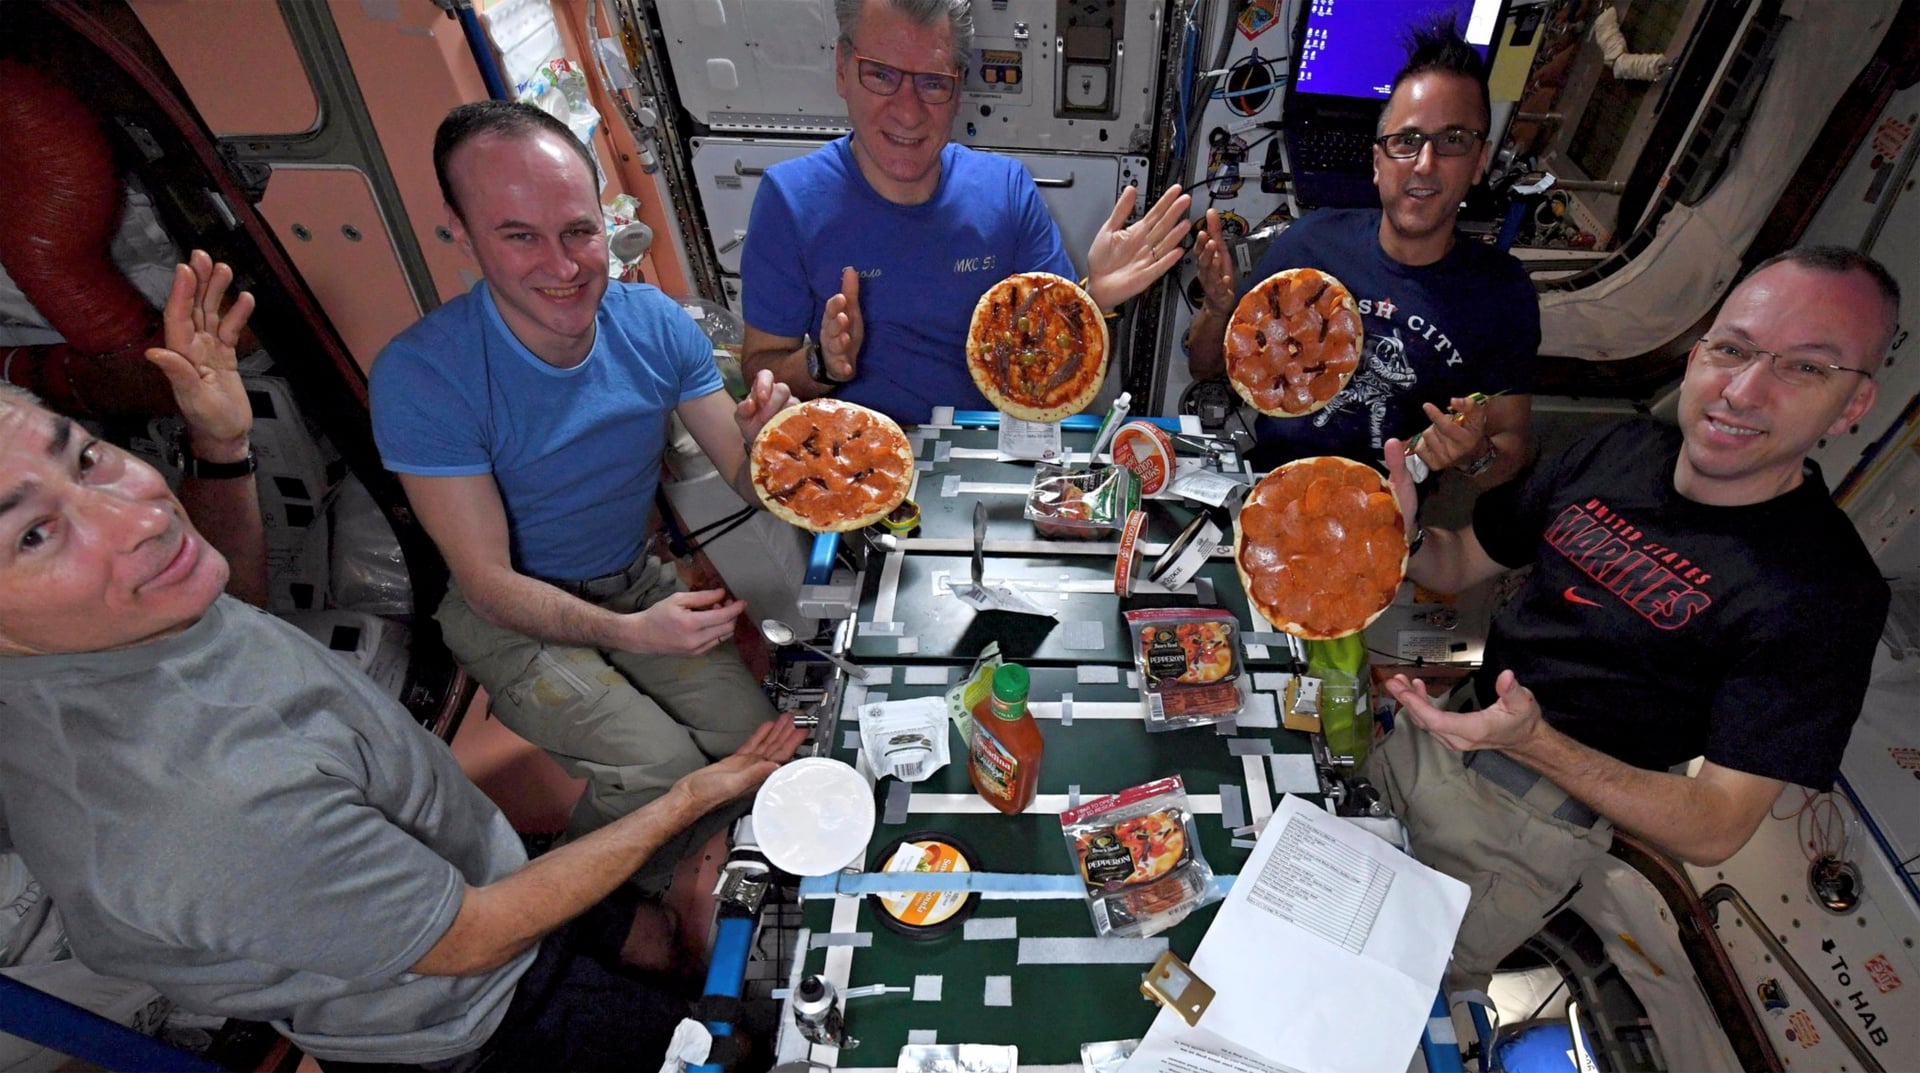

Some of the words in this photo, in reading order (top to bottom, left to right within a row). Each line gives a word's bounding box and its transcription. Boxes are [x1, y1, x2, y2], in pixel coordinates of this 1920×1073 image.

[1358, 299, 1396, 320] SH
[1407, 315, 1463, 367] CITY
[1134, 458, 1154, 476] GOUD
[1140, 464, 1161, 481] SMOK
[1544, 504, 1712, 631] MARINES
[1585, 498, 1643, 542] UNITED
[1643, 543, 1712, 585] STATES
[1087, 854, 1131, 871] PEPPERONI
[1831, 955, 1852, 986] TO
[1848, 990, 1889, 1047] HAB
